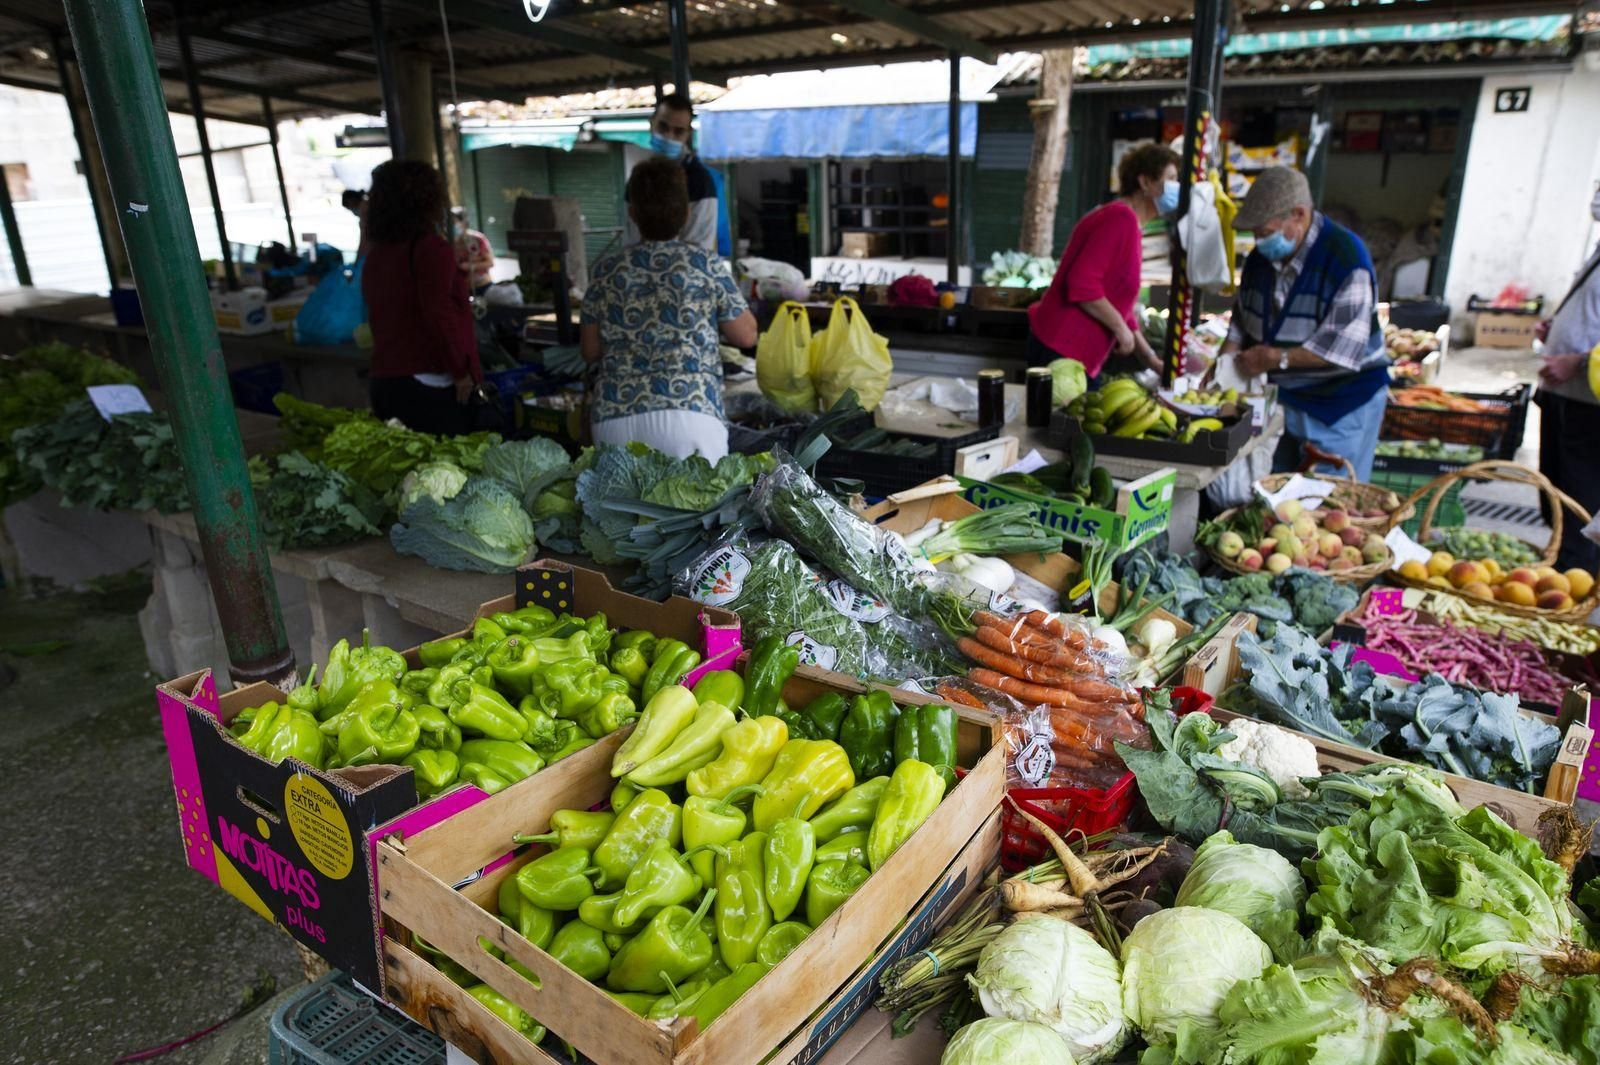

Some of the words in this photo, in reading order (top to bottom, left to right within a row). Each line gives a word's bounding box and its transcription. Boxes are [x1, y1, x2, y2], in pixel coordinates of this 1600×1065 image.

[1498, 90, 1527, 110] 67
[692, 549, 733, 594] MONTAÑITA
[290, 789, 322, 815] EXTRA
[301, 785, 338, 811] CATEGORÍA
[286, 905, 327, 943] plus
